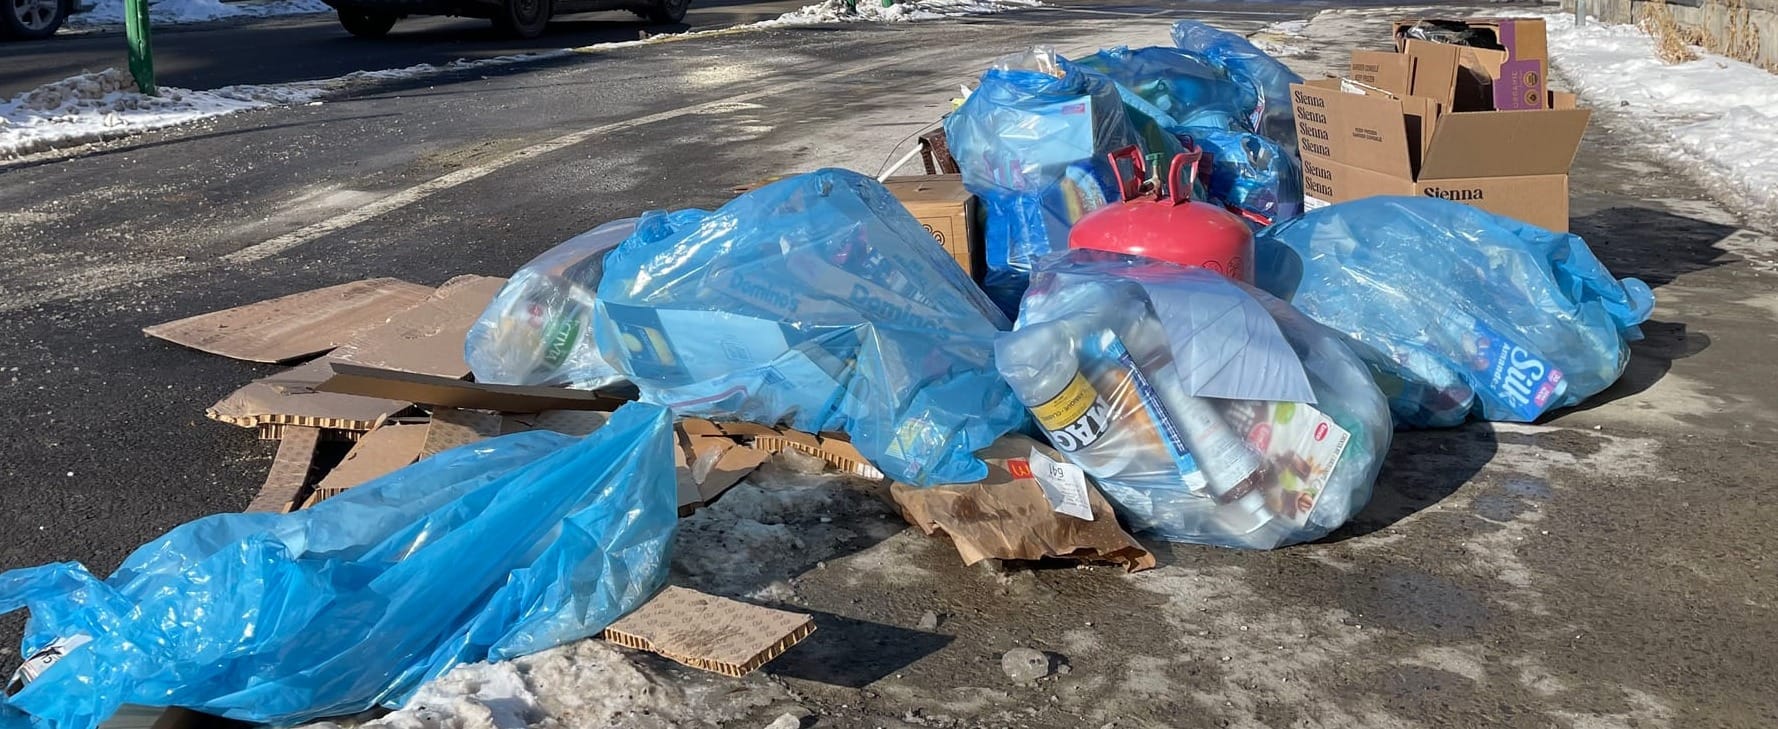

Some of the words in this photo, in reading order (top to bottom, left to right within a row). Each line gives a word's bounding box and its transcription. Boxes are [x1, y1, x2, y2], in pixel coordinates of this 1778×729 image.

[1295, 90, 1325, 108] Sienna
[1297, 106, 1327, 124] Sienna
[1299, 122, 1329, 140] Sienna
[1302, 137, 1330, 156] Sienna
[1304, 160, 1332, 180] Sienna
[1305, 176, 1333, 196] Sienna
[1424, 187, 1484, 201] Sienna
[1499, 346, 1545, 408] Silk
[1049, 463, 1064, 478] 641
